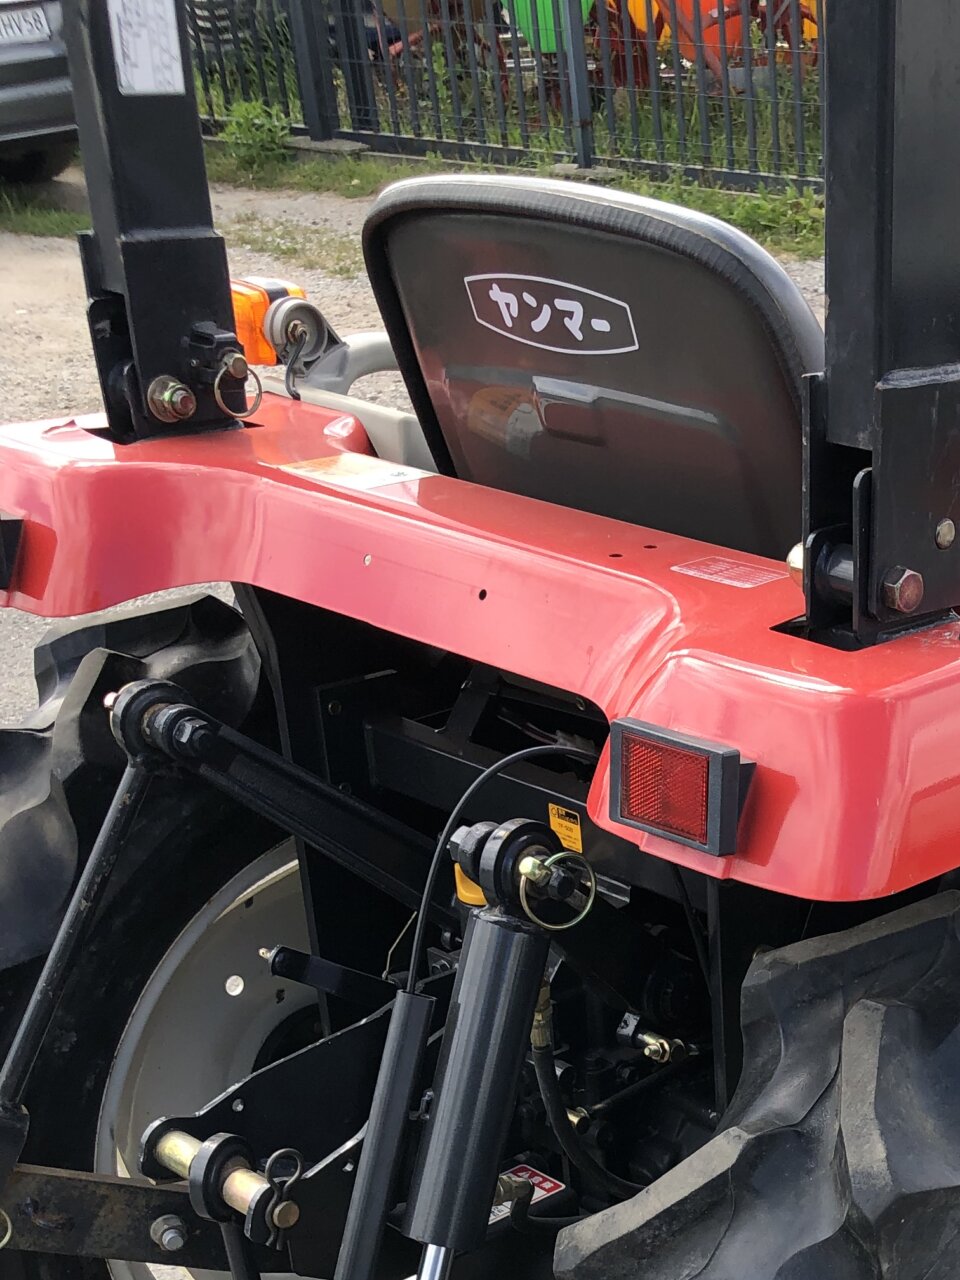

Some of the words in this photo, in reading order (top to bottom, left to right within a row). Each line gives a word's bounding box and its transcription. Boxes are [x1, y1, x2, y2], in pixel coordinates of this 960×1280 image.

[0, 10, 43, 39] HV58
[488, 283, 611, 341] ヤンマー
